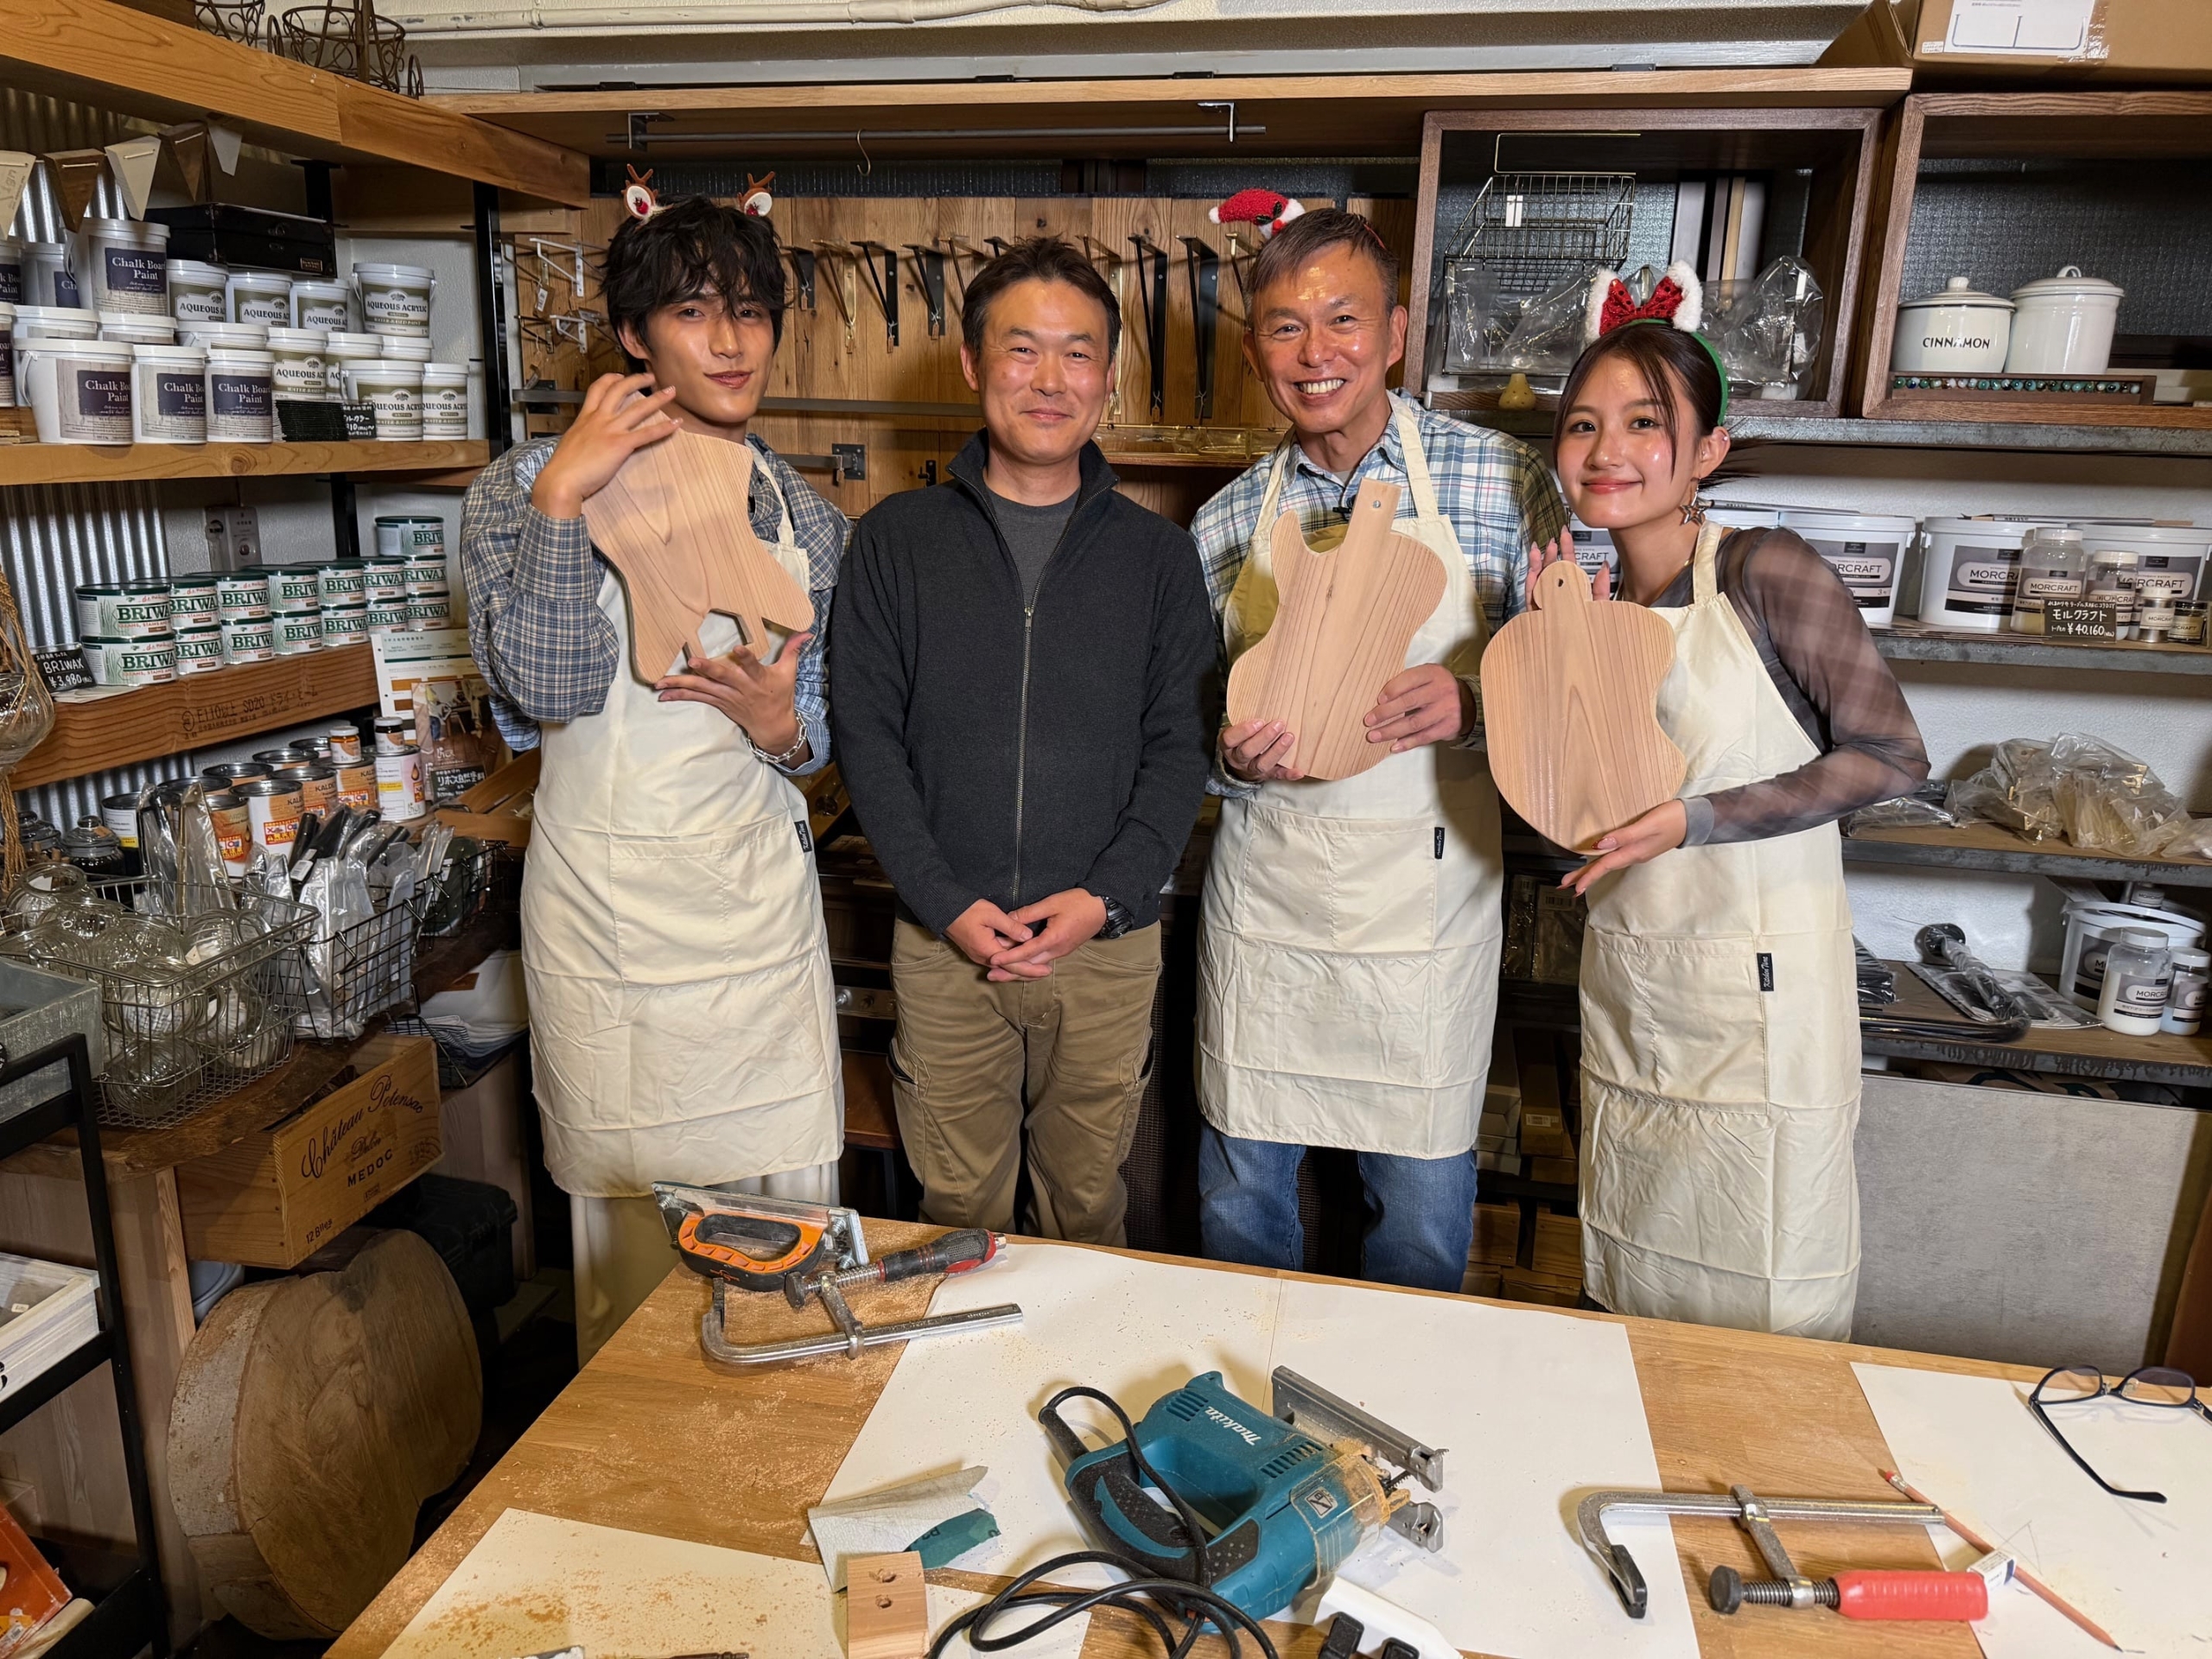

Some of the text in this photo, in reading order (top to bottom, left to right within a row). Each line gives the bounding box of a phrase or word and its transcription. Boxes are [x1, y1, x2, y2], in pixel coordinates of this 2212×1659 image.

[112, 257, 146, 270] Chalk
[133, 269, 158, 280] Paint
[180, 302, 220, 315] AQUEOUS
[366, 301, 401, 311] AQUEOUS
[244, 308, 282, 320] AQUEOUS
[306, 315, 341, 326] AQUEOUS
[1923, 337, 1991, 349] CINNAMON
[276, 368, 316, 379] AQUEOUS
[86, 379, 118, 391] Chalk
[164, 382, 194, 392] Chalk
[218, 383, 251, 393] Chalk
[107, 392, 129, 402] Paint
[185, 394, 204, 404] Paint
[238, 394, 263, 404] Paint
[373, 403, 404, 411] QUEOUS
[1574, 552, 1609, 561] CRAFT
[1835, 563, 1882, 574] RCRAFT
[283, 583, 318, 597] BRIW
[2031, 582, 2079, 593] MORCRAFT
[170, 596, 218, 612] BRIWA
[221, 591, 270, 606] BRIWA
[118, 603, 170, 621] BRIWA
[2052, 608, 2107, 622] モルクラフト
[325, 618, 368, 632] BRIWA
[285, 625, 321, 639] BRIW
[175, 641, 223, 657] BRIWA
[43, 658, 85, 674] BRIWAX
[123, 652, 174, 669] BRIWA
[243, 696, 265, 714] SD20
[347, 1148, 393, 1188] MEDOC
[306, 1230, 315, 1244] 12
